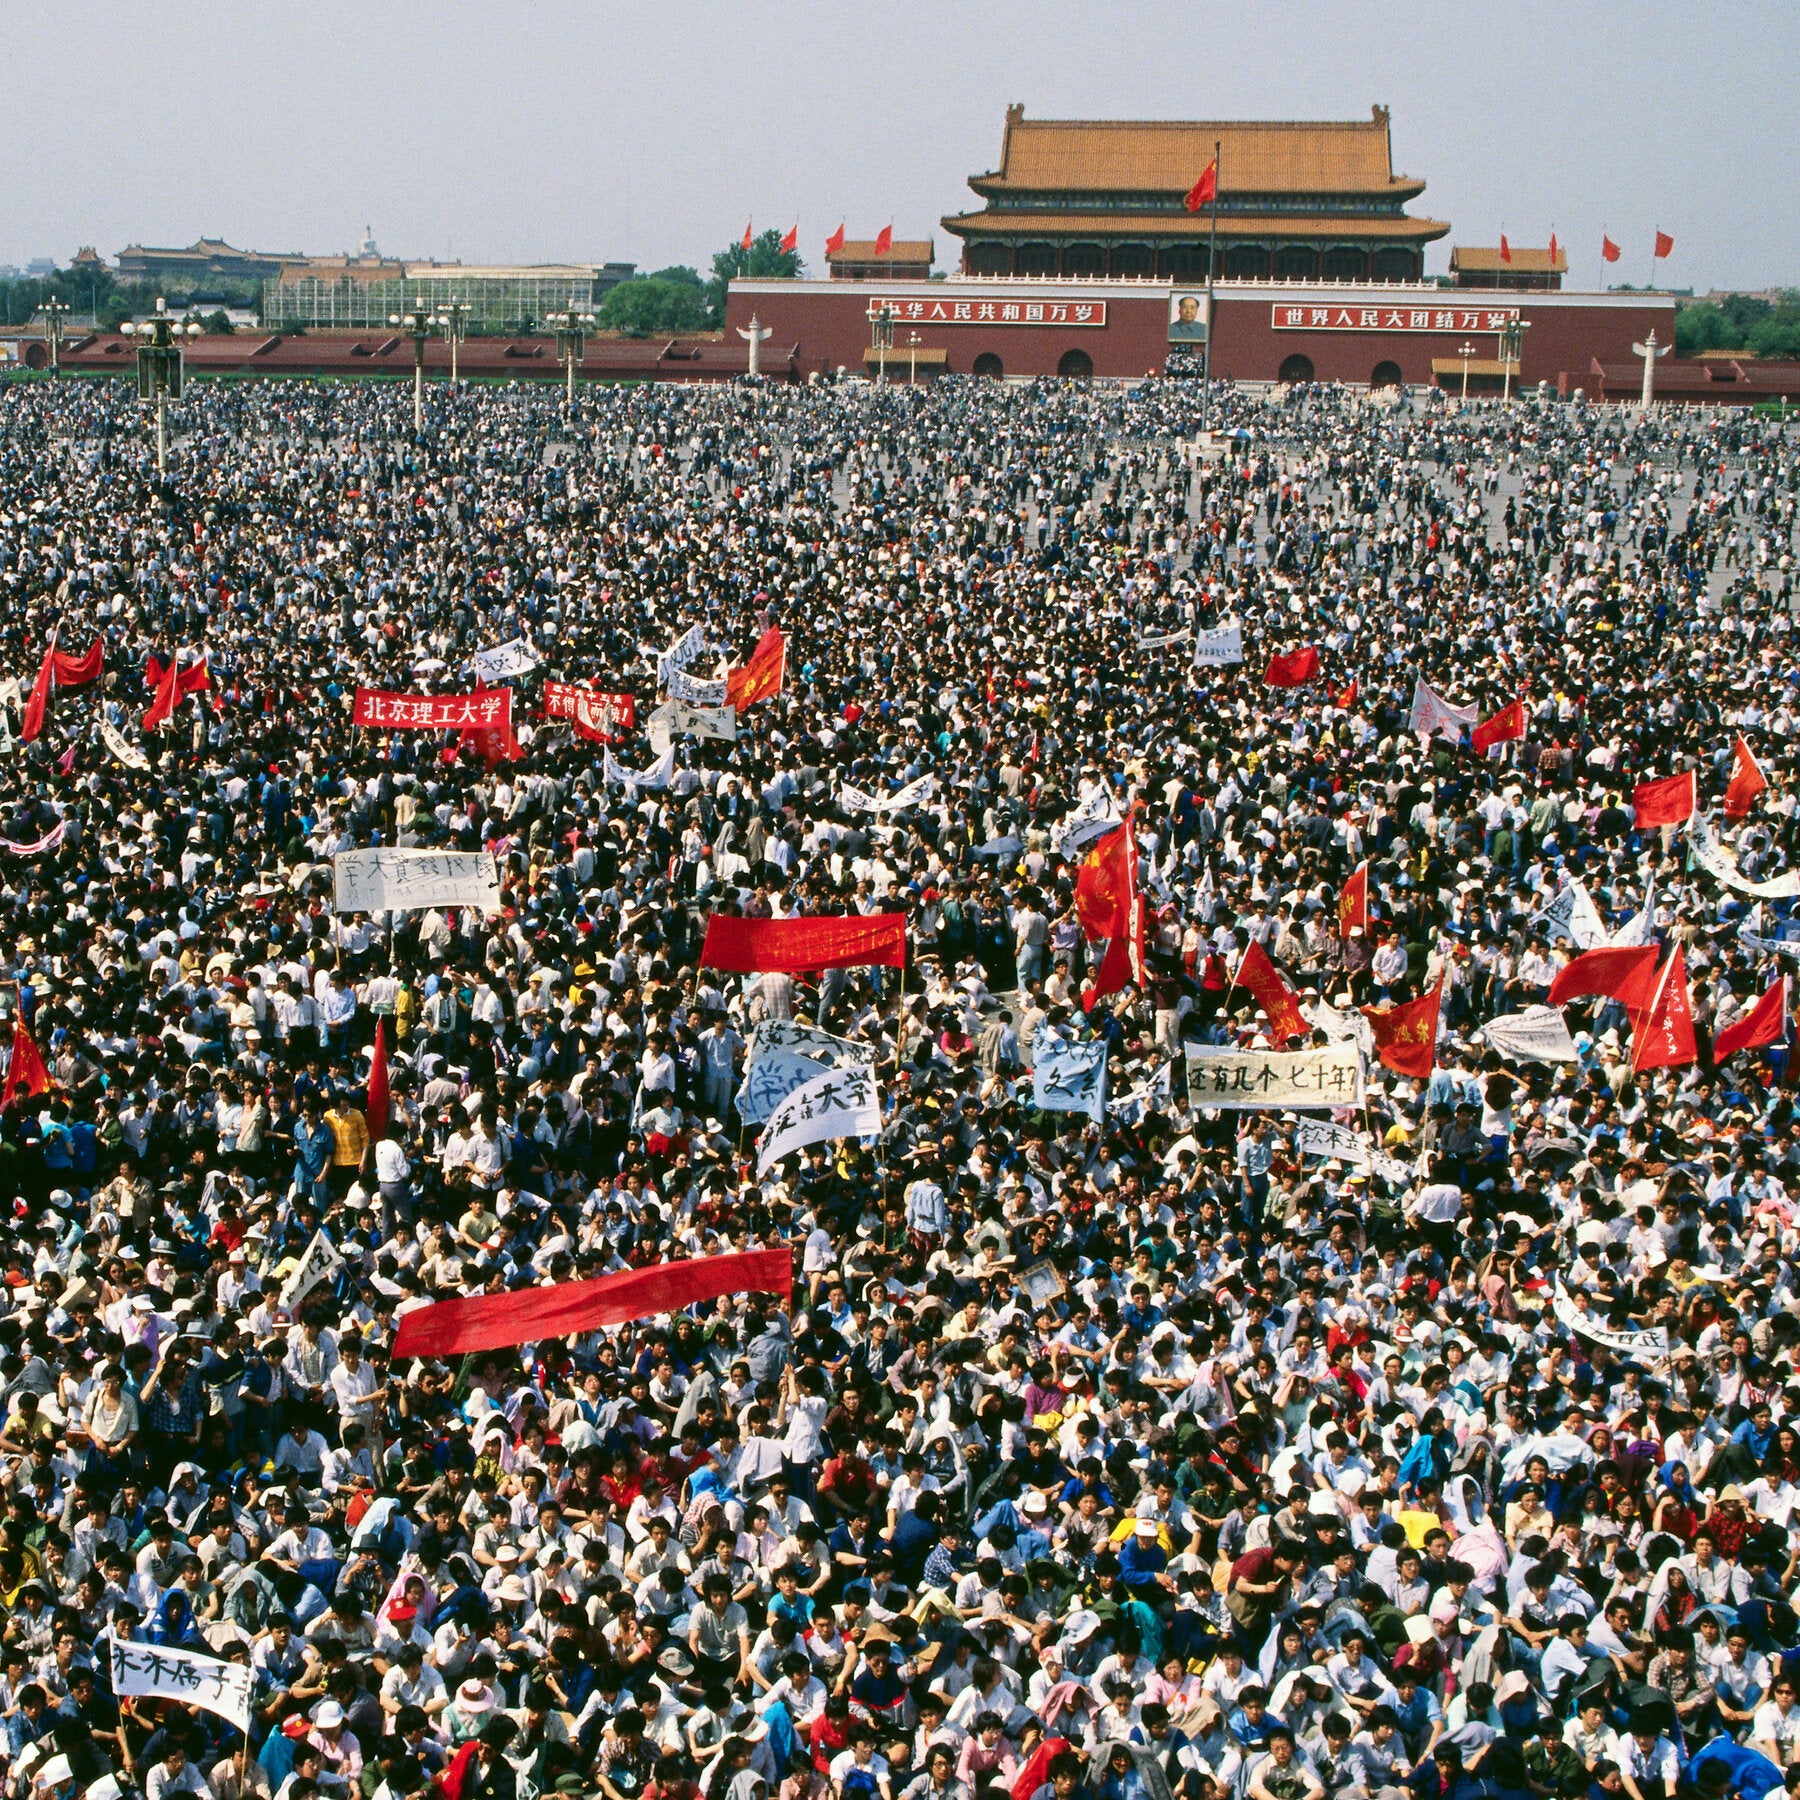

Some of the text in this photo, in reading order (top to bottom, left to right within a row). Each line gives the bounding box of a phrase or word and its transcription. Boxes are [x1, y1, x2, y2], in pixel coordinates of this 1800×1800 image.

[885, 302, 1093, 322] 中华人民共和国万岁
[1286, 308, 1506, 329] 世界人民大团结万岁
[363, 696, 502, 725] 北京理工大学
[1188, 1063, 1358, 1092] 还有几个七十年?
